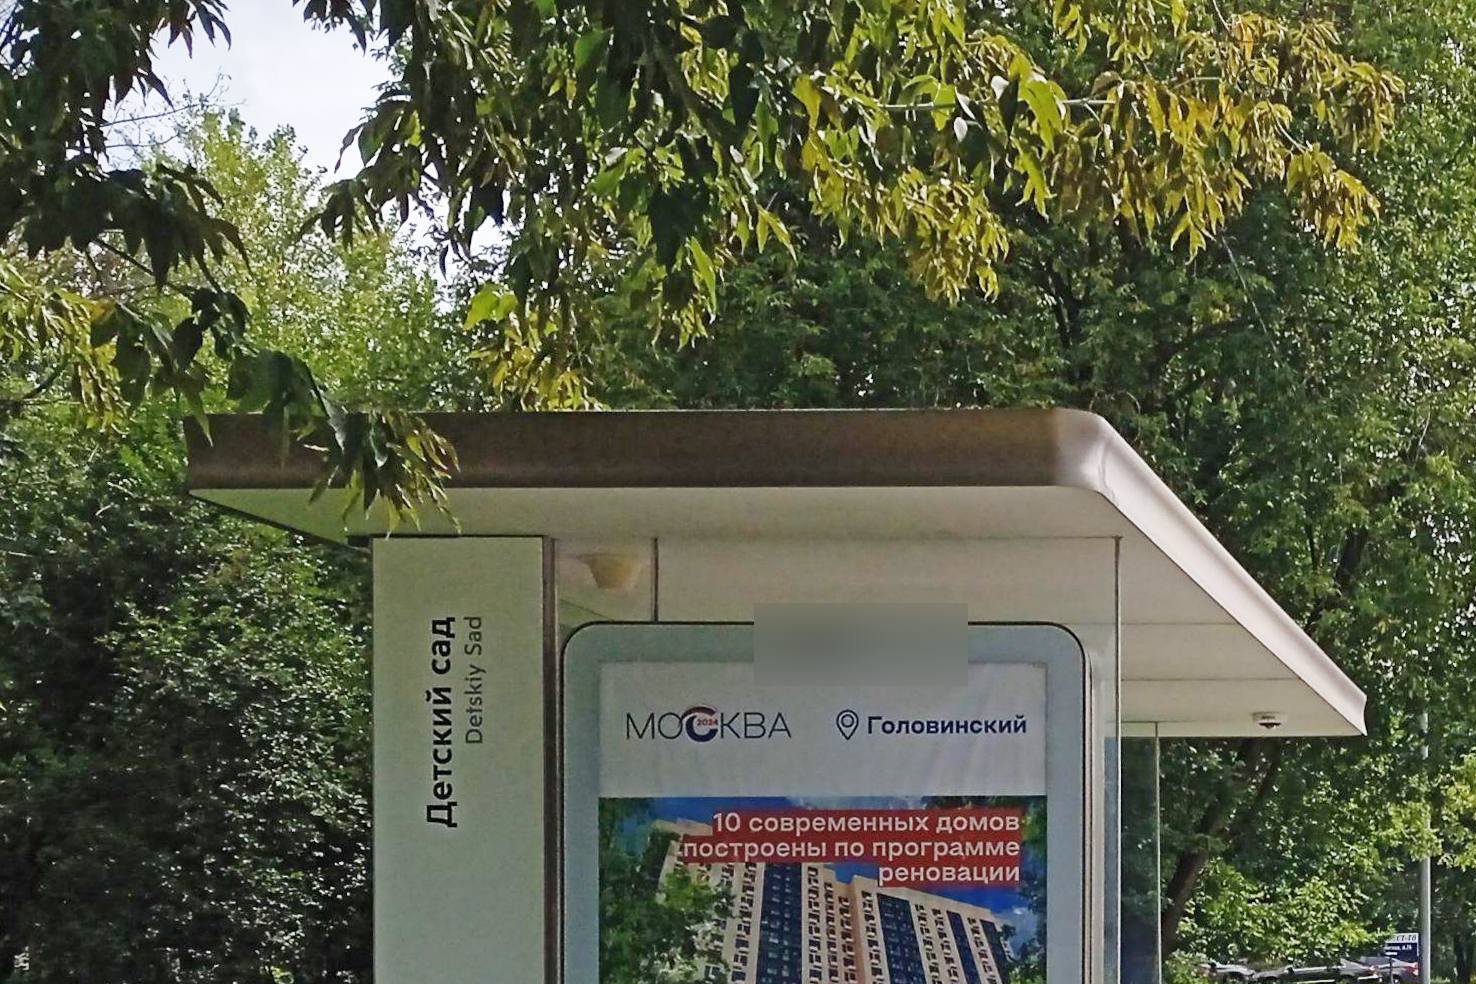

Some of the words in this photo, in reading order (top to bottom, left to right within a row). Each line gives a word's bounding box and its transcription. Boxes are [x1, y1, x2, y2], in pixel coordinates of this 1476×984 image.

[432, 616, 455, 675] сад
[464, 616, 482, 656] Sad
[464, 664, 487, 744] Detskiy
[626, 705, 792, 743] МОСКВА
[868, 714, 1027, 734] Головинский
[425, 687, 458, 828] Детский
[713, 812, 741, 832] 10
[749, 815, 929, 836] современных
[936, 815, 1020, 834] домов
[683, 841, 827, 862] построены
[834, 841, 865, 857] по
[872, 841, 1020, 862] программе
[879, 866, 1020, 887] реновации
